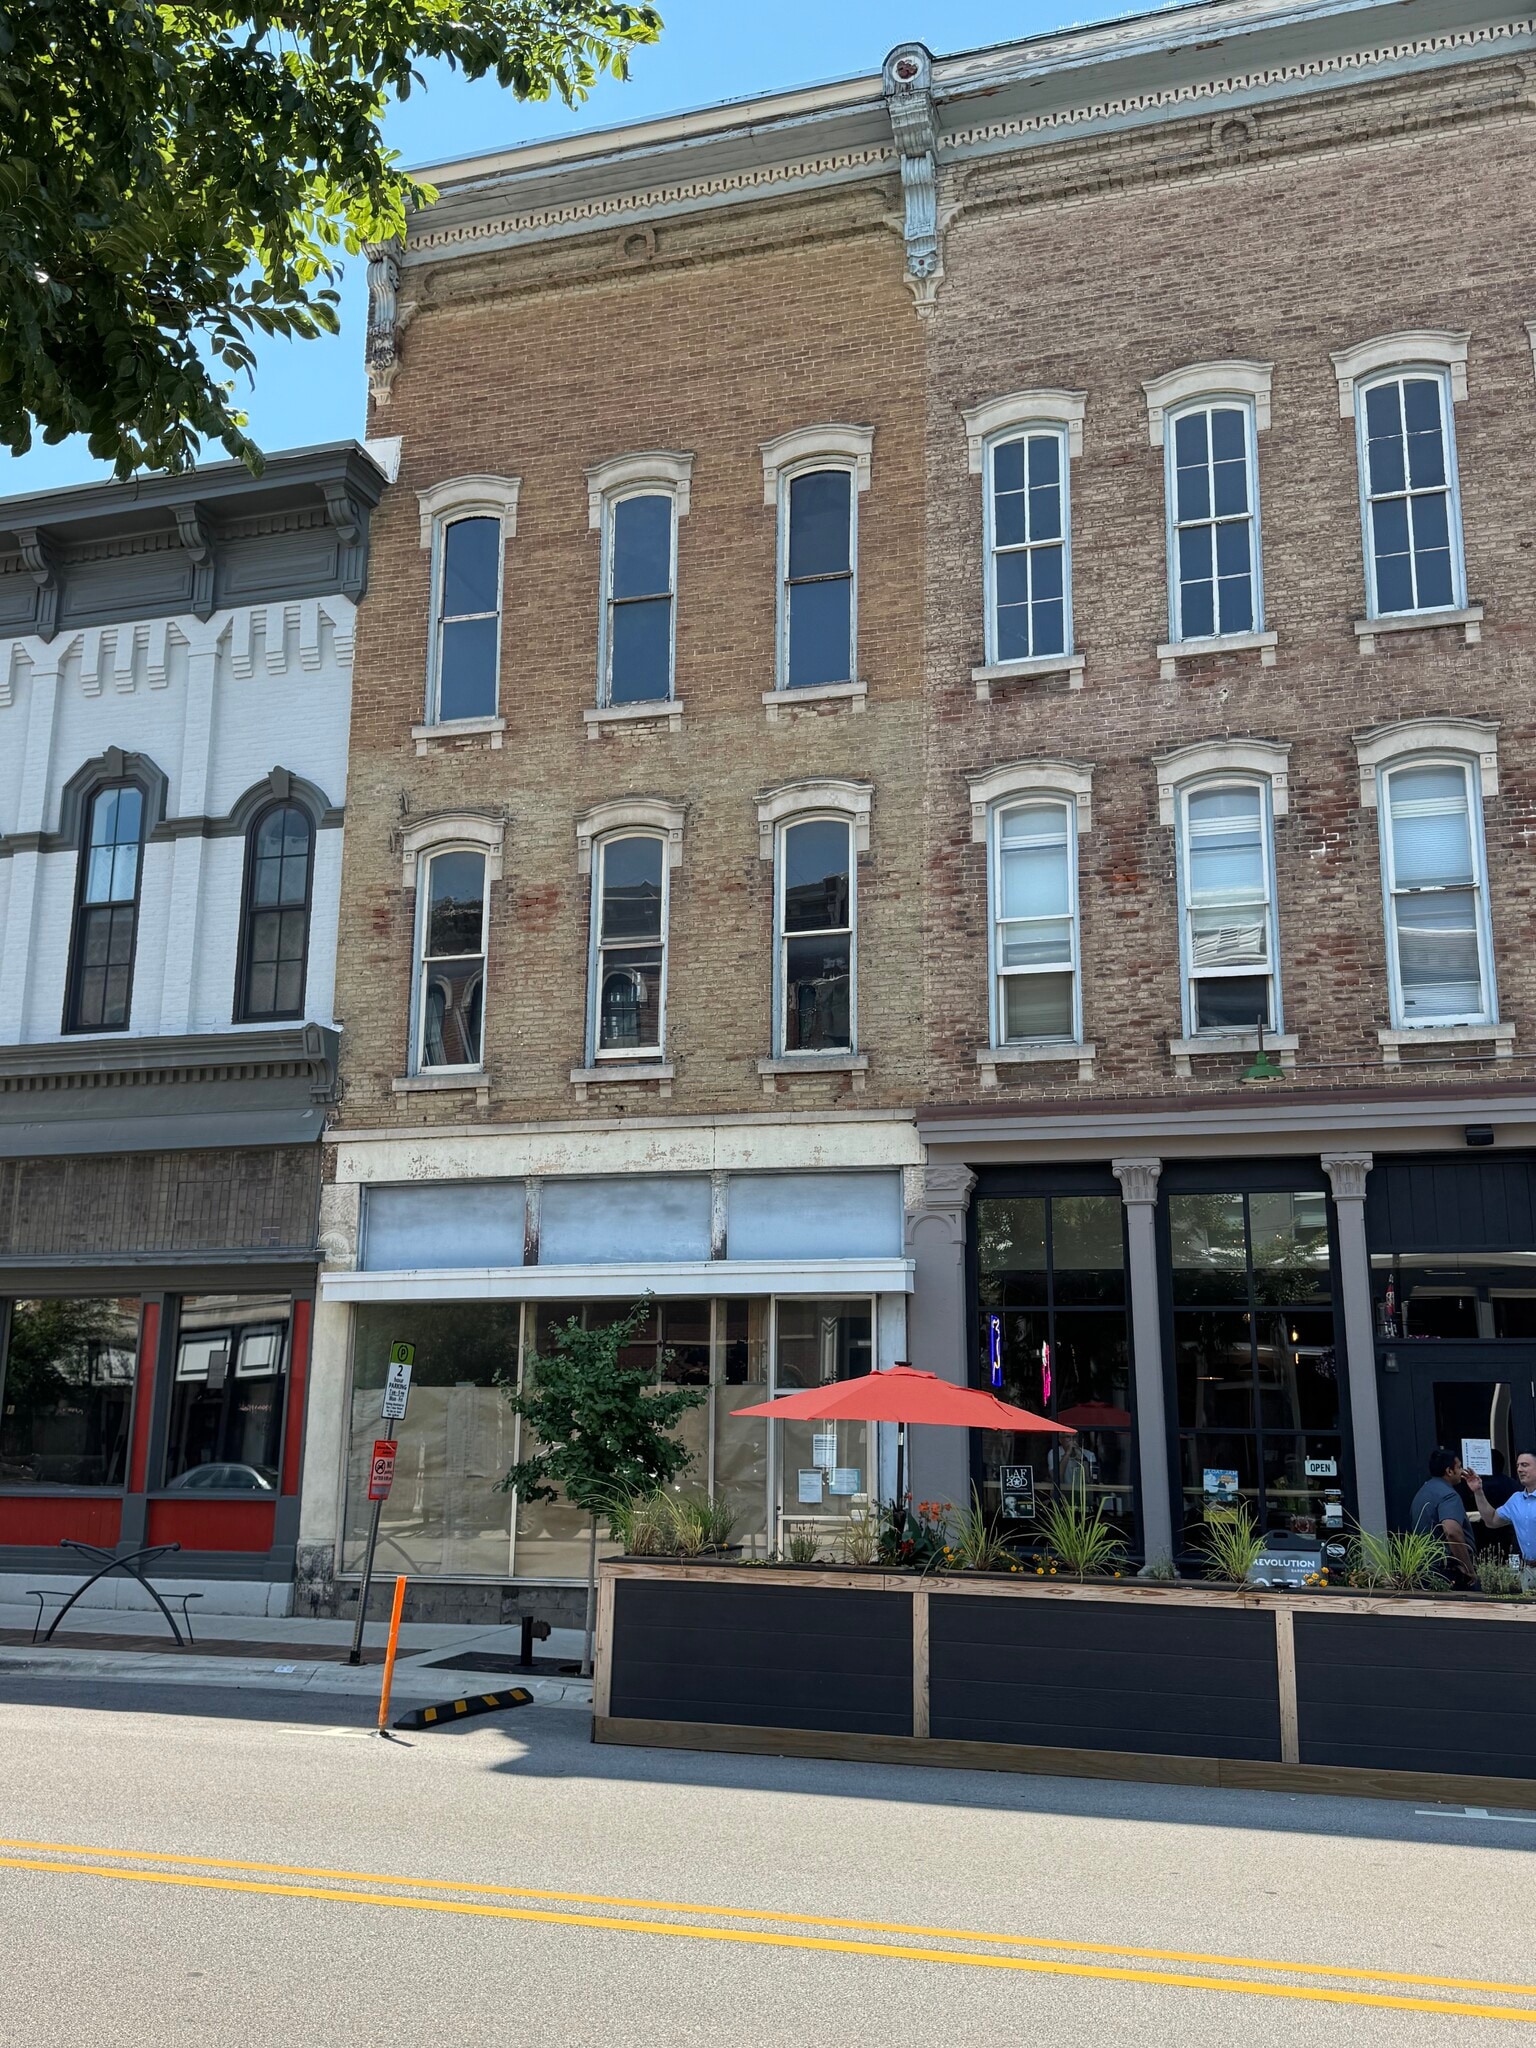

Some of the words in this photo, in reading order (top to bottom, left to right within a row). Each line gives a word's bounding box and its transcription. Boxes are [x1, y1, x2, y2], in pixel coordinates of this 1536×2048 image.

[396, 1365, 404, 1377] 2
[388, 1382, 407, 1391] PARKING
[1006, 1468, 1028, 1478] LAF
[1310, 1463, 1331, 1473] OPEN
[1253, 1558, 1315, 1568] REVOLUTION
